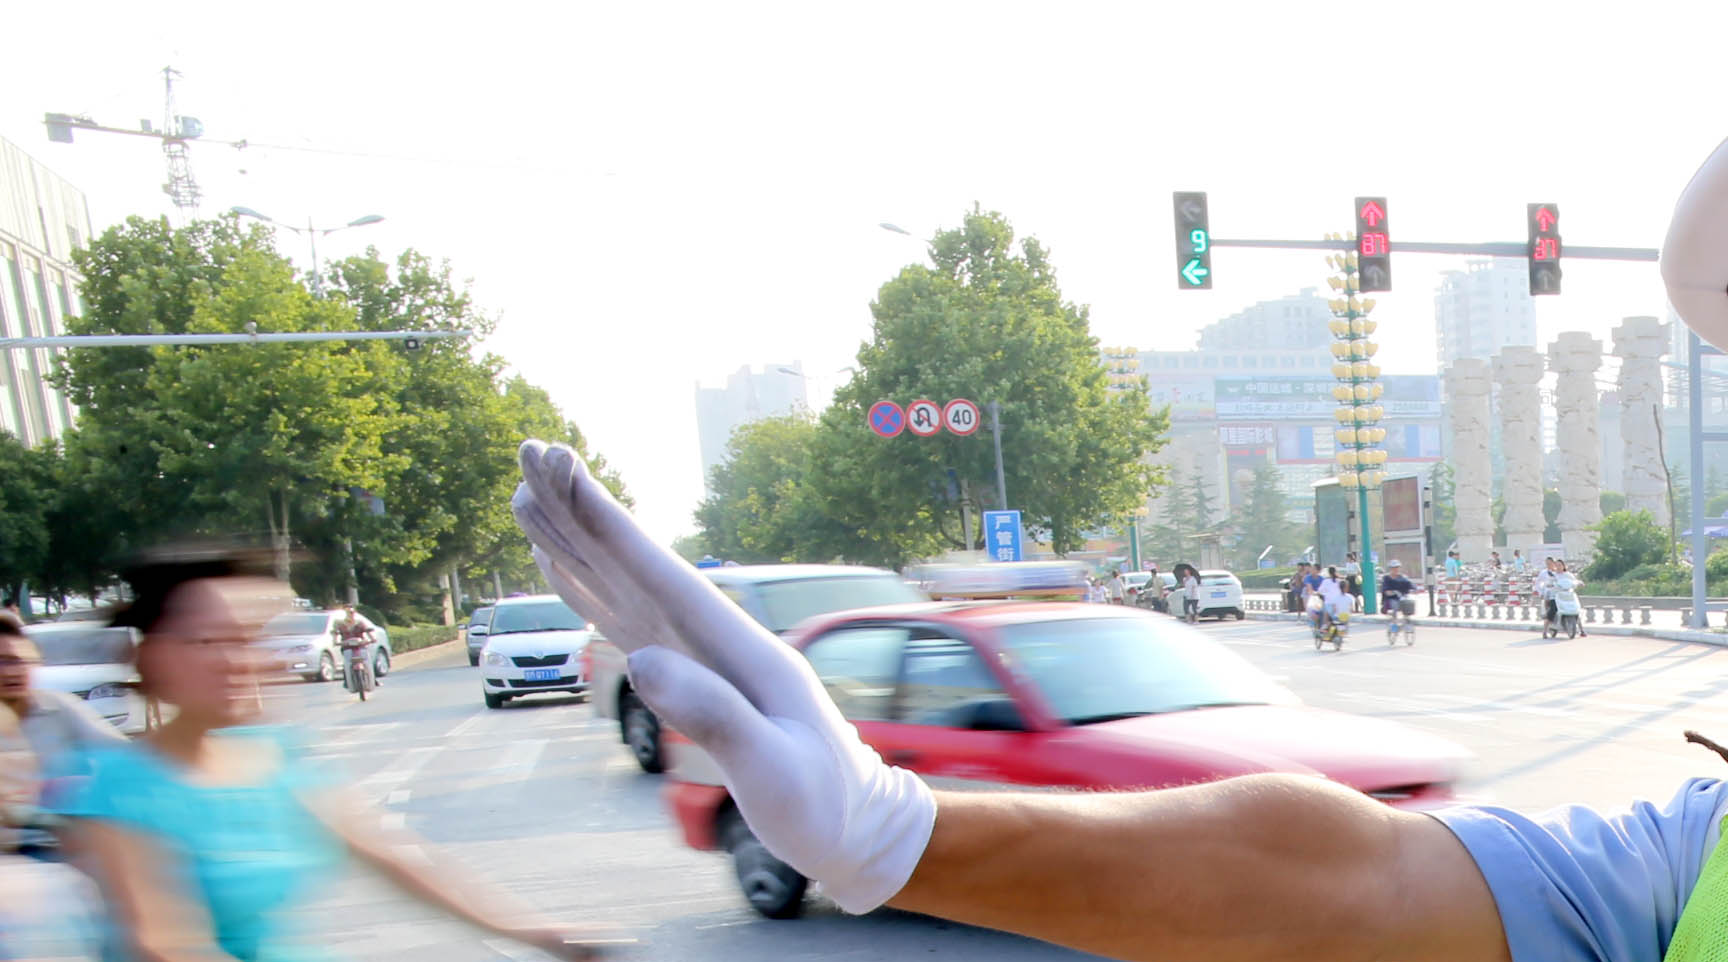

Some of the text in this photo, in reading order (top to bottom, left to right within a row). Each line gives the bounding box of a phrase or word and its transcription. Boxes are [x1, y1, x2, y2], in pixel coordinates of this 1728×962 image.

[1190, 230, 1208, 253] 9
[1361, 233, 1388, 255] 87
[953, 410, 971, 425] 40
[996, 516, 1014, 561] 严管街
